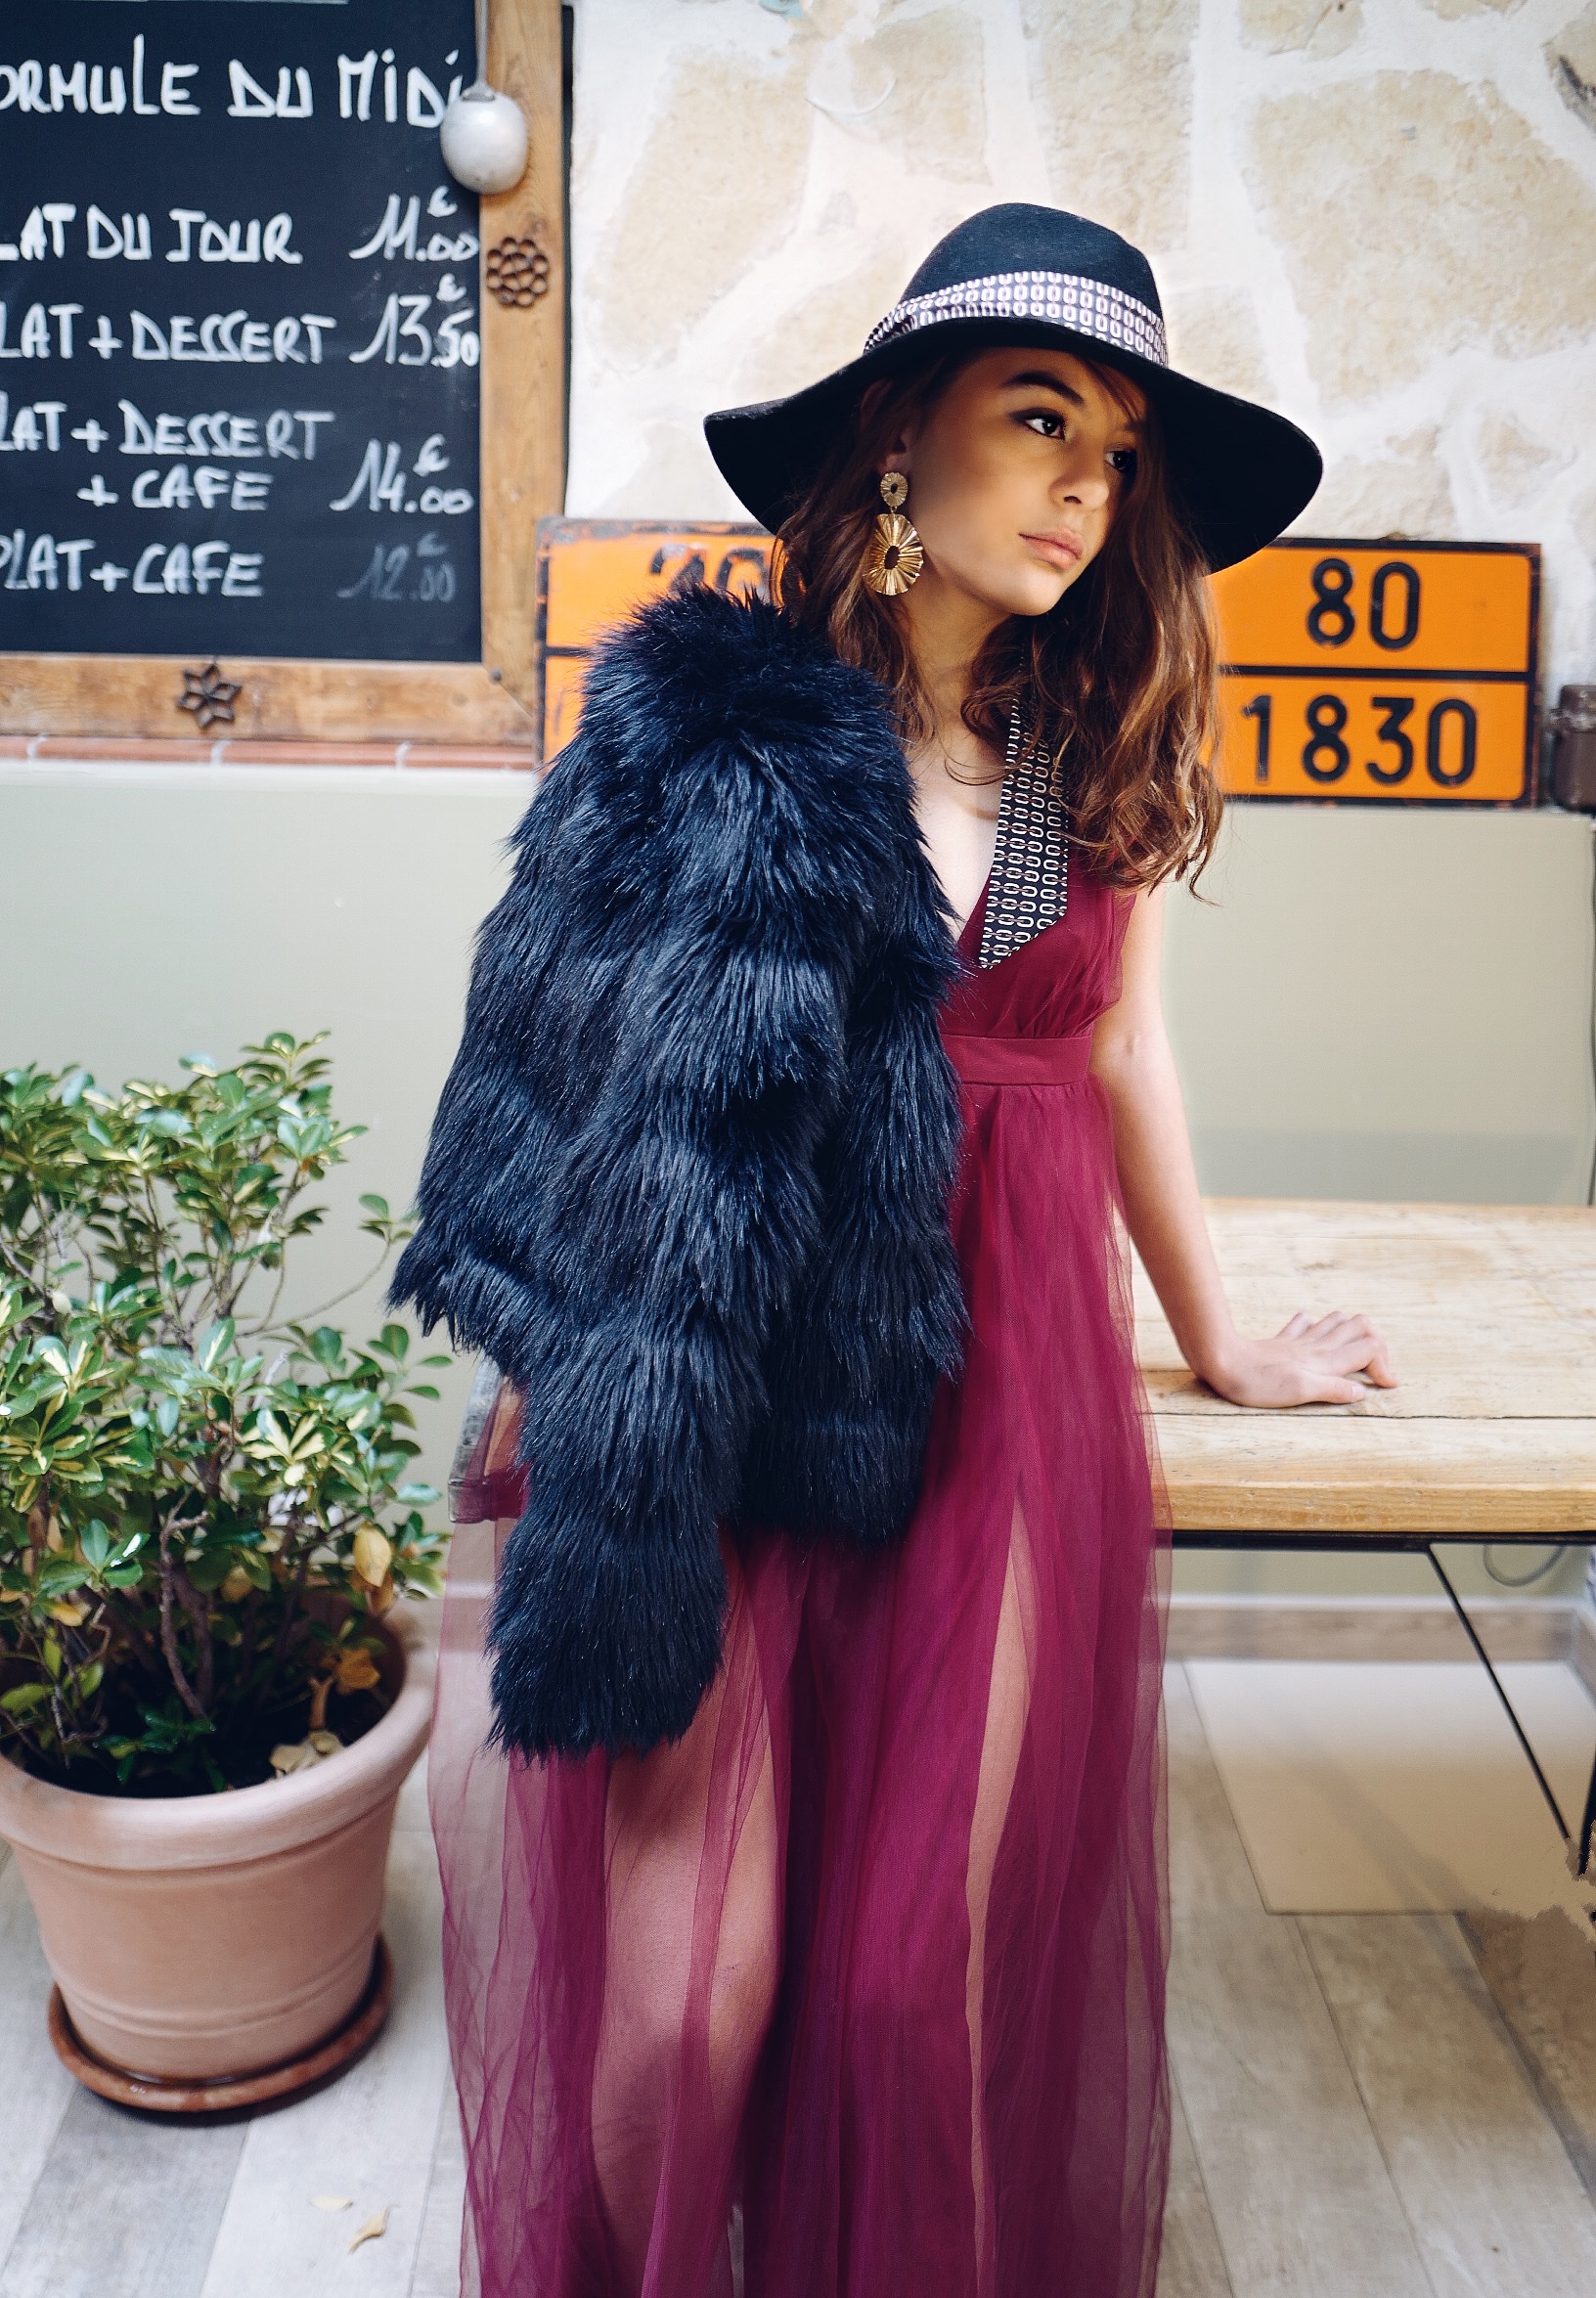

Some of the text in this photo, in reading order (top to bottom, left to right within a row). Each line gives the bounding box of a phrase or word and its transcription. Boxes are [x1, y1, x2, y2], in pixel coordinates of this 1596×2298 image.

[227, 59, 314, 117] DU
[86, 203, 152, 260] DU
[165, 207, 303, 264] JOUR
[130, 309, 337, 365] DESSERT
[117, 398, 335, 461] DESSERT
[132, 464, 274, 510] CAFE
[133, 540, 265, 597] CAFE
[1307, 557, 1421, 651] 80
[1242, 694, 1478, 787] 1830
